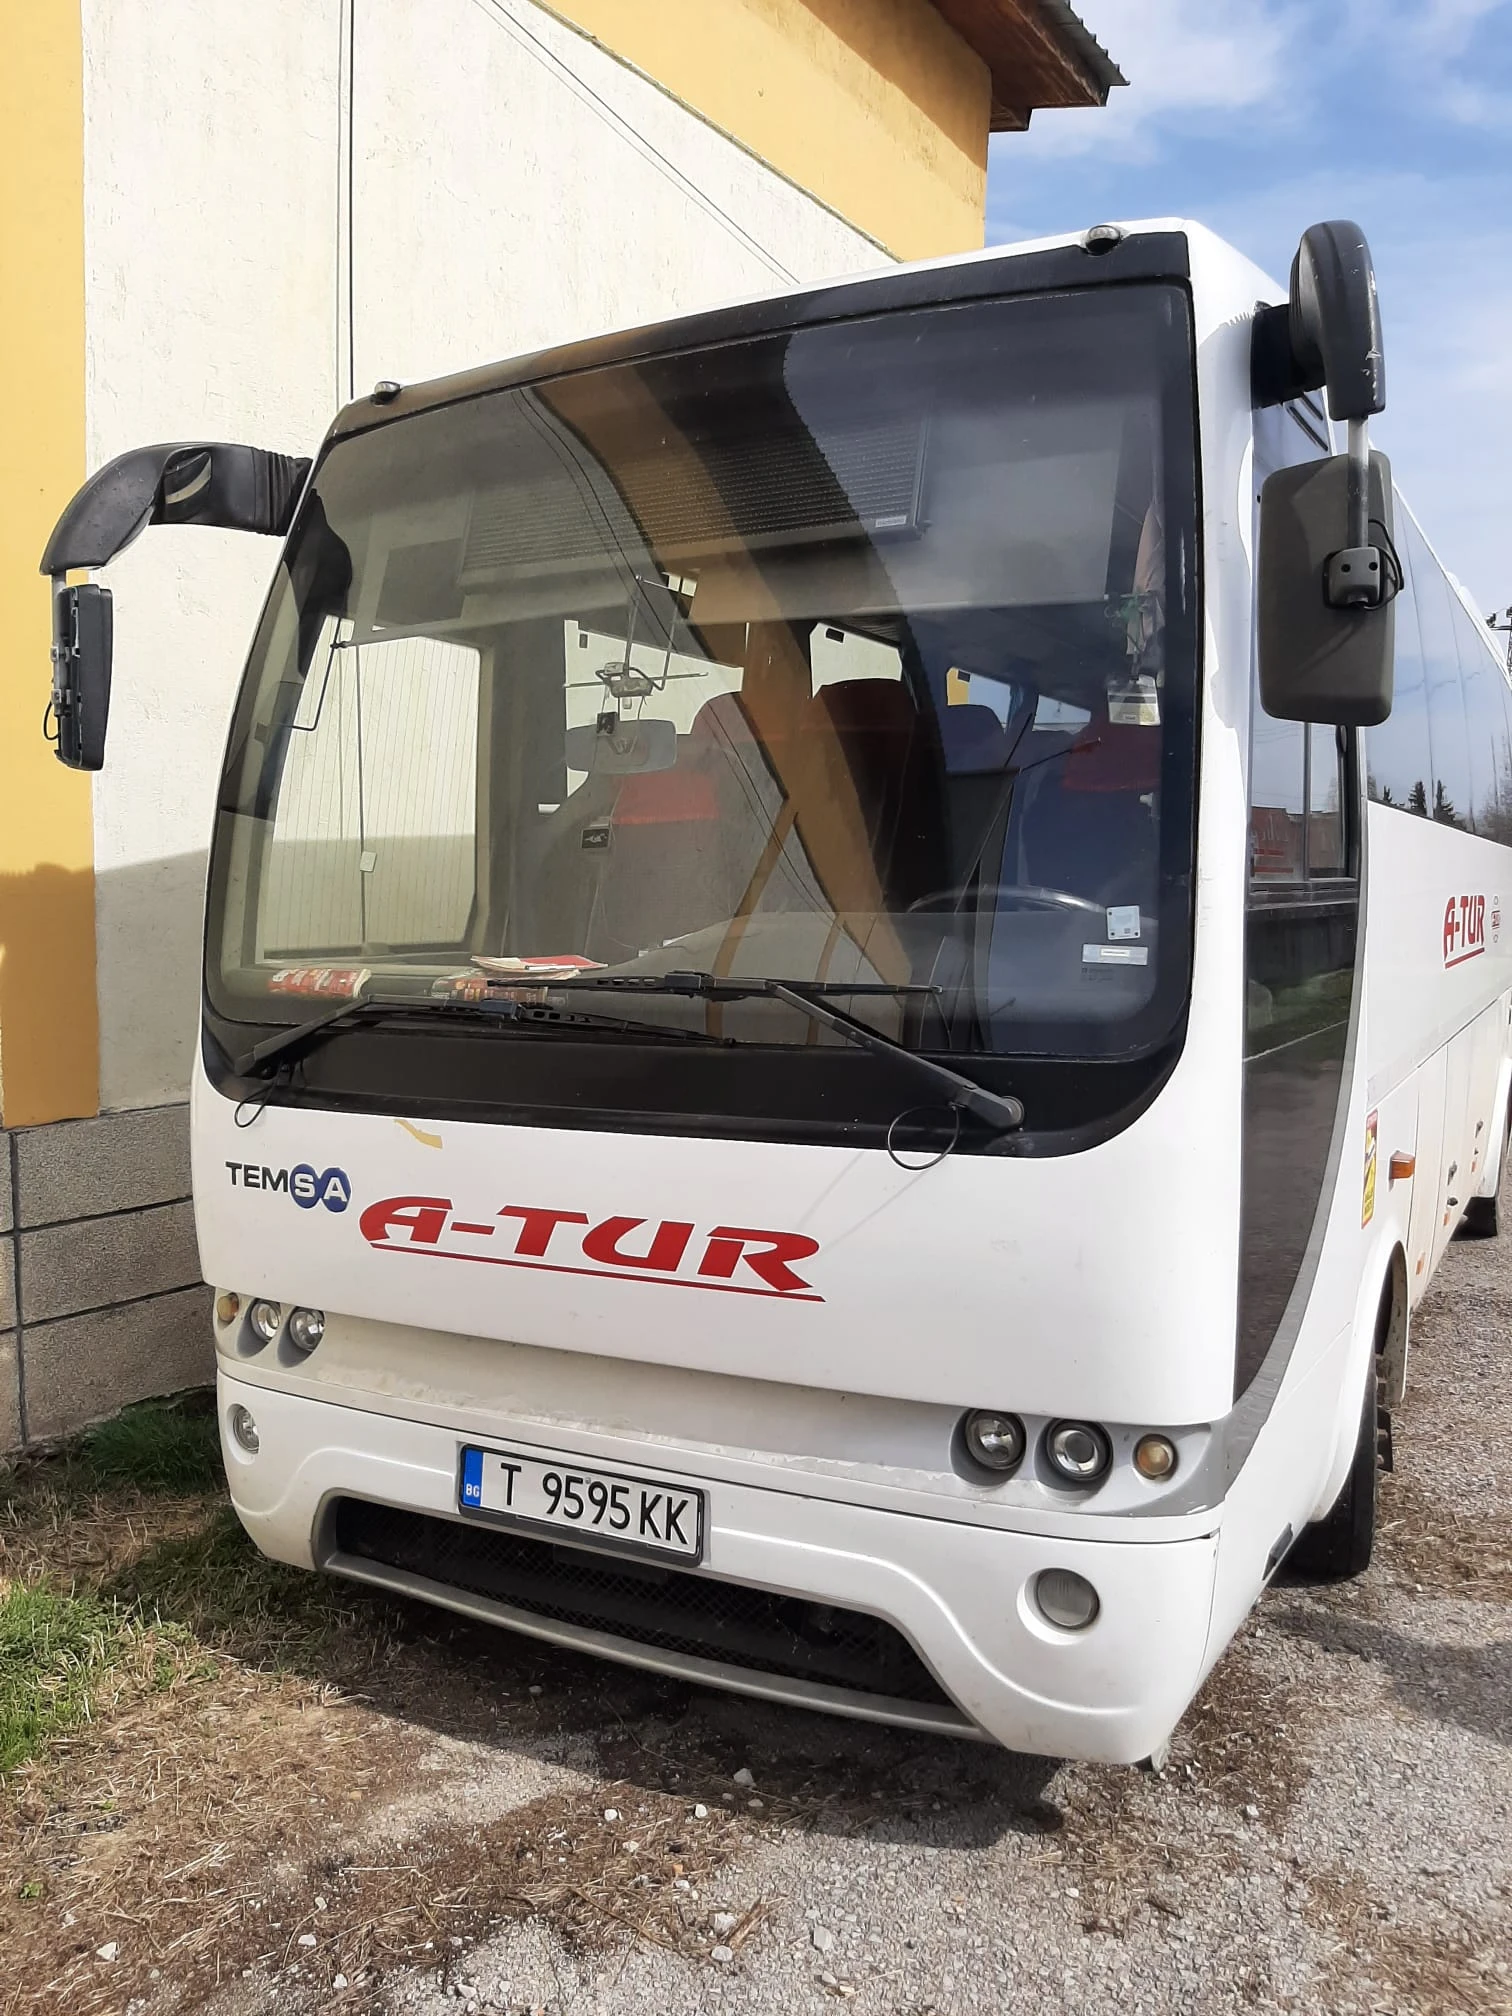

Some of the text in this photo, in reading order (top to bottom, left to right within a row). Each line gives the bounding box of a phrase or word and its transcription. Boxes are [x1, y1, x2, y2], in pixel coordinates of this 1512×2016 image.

[1443, 895, 1484, 961] A-TUR
[225, 1161, 349, 1202] TEMSA
[359, 1196, 820, 1291] A-TUR
[465, 1483, 480, 1498] BG
[500, 1462, 522, 1506] T
[542, 1472, 631, 1530] 9595
